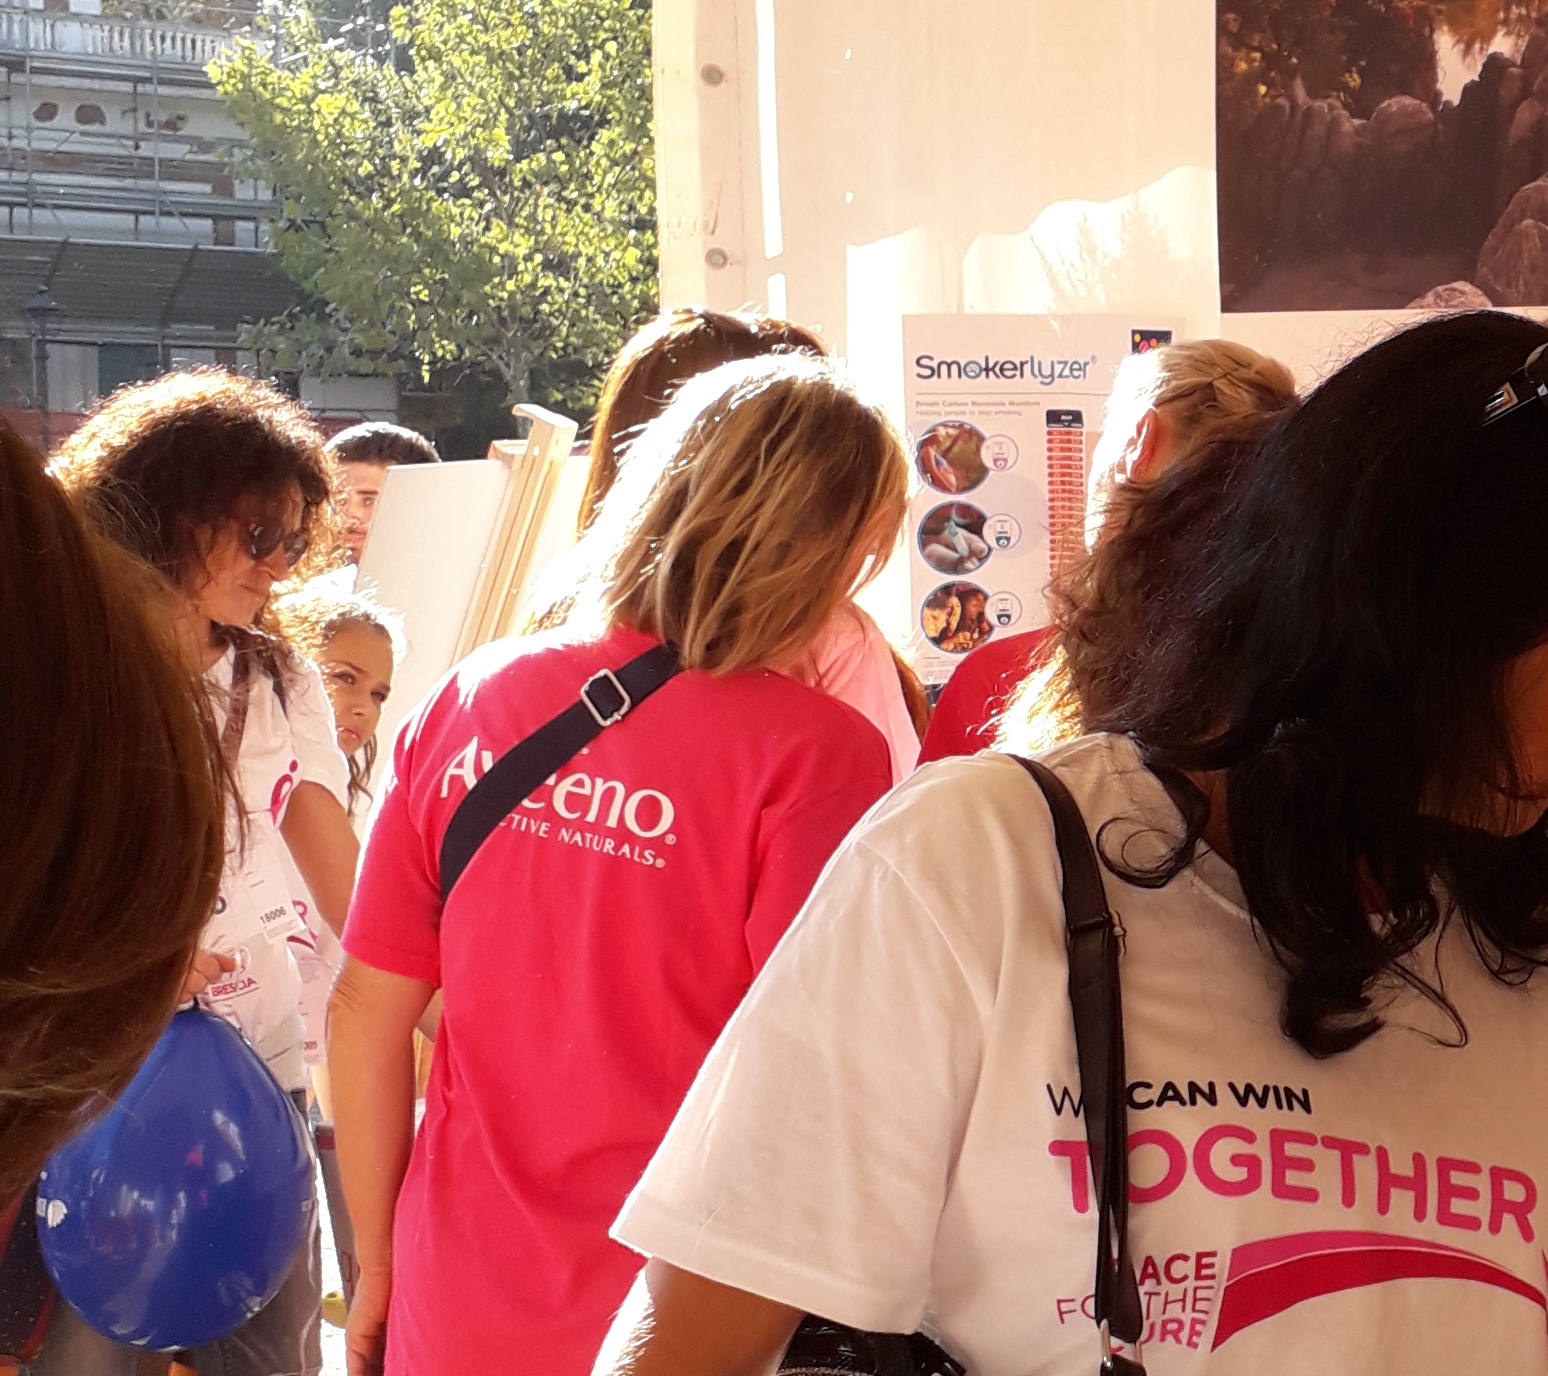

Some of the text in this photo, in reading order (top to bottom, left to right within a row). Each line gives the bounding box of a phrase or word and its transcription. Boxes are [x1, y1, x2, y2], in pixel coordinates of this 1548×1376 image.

[439, 735, 675, 839] Aeno
[500, 814, 656, 867] TIVE NATURALS
[1046, 1080, 1313, 1118] W CAN WIN
[1048, 1125, 1538, 1243] TOGETHER
[1138, 1250, 1218, 1287] ACE
[1143, 1286, 1217, 1316] THE
